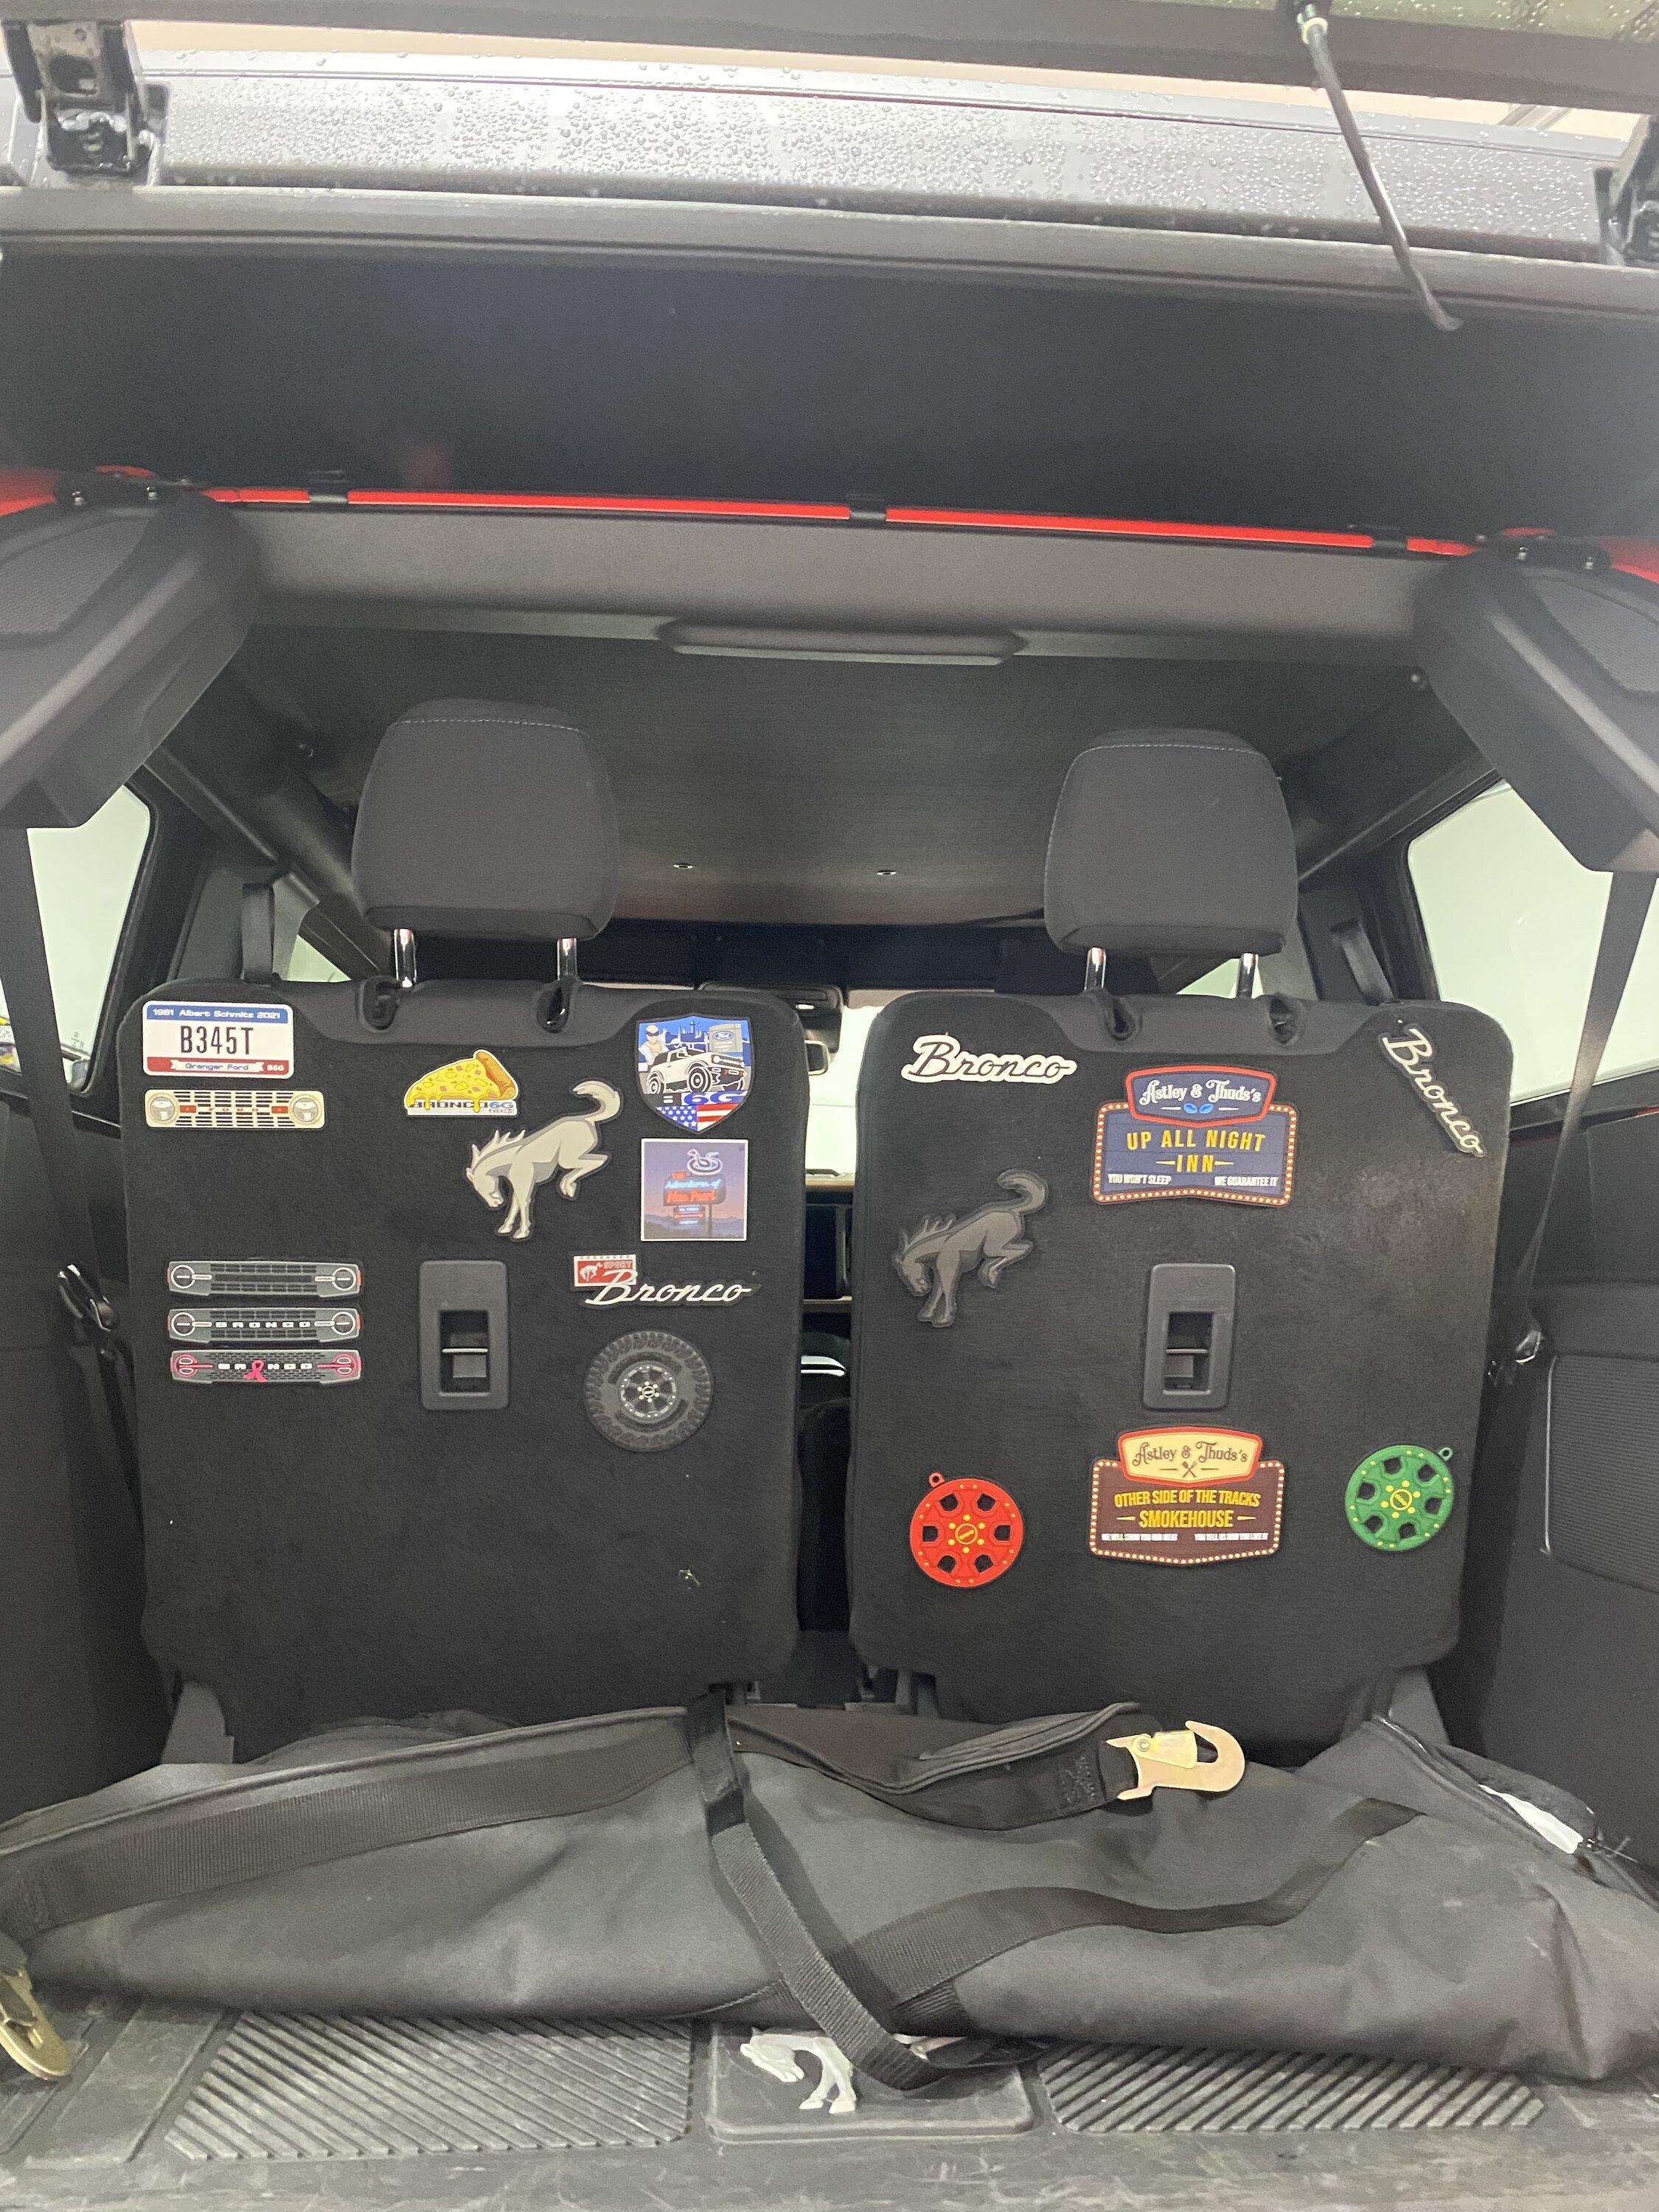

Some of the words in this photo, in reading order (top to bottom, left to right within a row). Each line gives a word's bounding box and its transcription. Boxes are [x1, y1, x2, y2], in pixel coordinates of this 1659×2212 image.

[178, 1009, 211, 1018] Albert
[214, 1010, 254, 1019] Schmitz
[257, 1012, 280, 1020] 2021
[180, 1025, 254, 1055] B345T
[185, 1062, 223, 1071] Granger
[908, 1041, 1071, 1079] Bronco
[1139, 1079, 1187, 1105] Astley
[1190, 1083, 1203, 1098] &
[1206, 1079, 1262, 1103] Thuds's
[1382, 1029, 1484, 1152] Bronco
[1127, 1131, 1152, 1150] UP
[1161, 1130, 1196, 1148] ALL
[1206, 1130, 1265, 1152] NIGHT
[1176, 1155, 1214, 1172] INN
[1107, 1173, 1123, 1183] YOU
[1147, 1175, 1172, 1185] SLEEP
[1214, 1176, 1227, 1186] WE
[1227, 1176, 1270, 1186] GUARANTEE
[1270, 1176, 1279, 1186] IT
[585, 1269, 752, 1305] Bronco
[1132, 1442, 1177, 1467] Astley
[1181, 1445, 1192, 1459] &
[1195, 1441, 1248, 1463] Thuds's
[1114, 1491, 1150, 1507] OTHER
[1152, 1489, 1178, 1504] SIDE
[1179, 1489, 1194, 1503] OF
[1195, 1489, 1217, 1504] THE
[1218, 1489, 1262, 1508] TRACKS
[1138, 1510, 1234, 1528] SMOKEHOUSE
